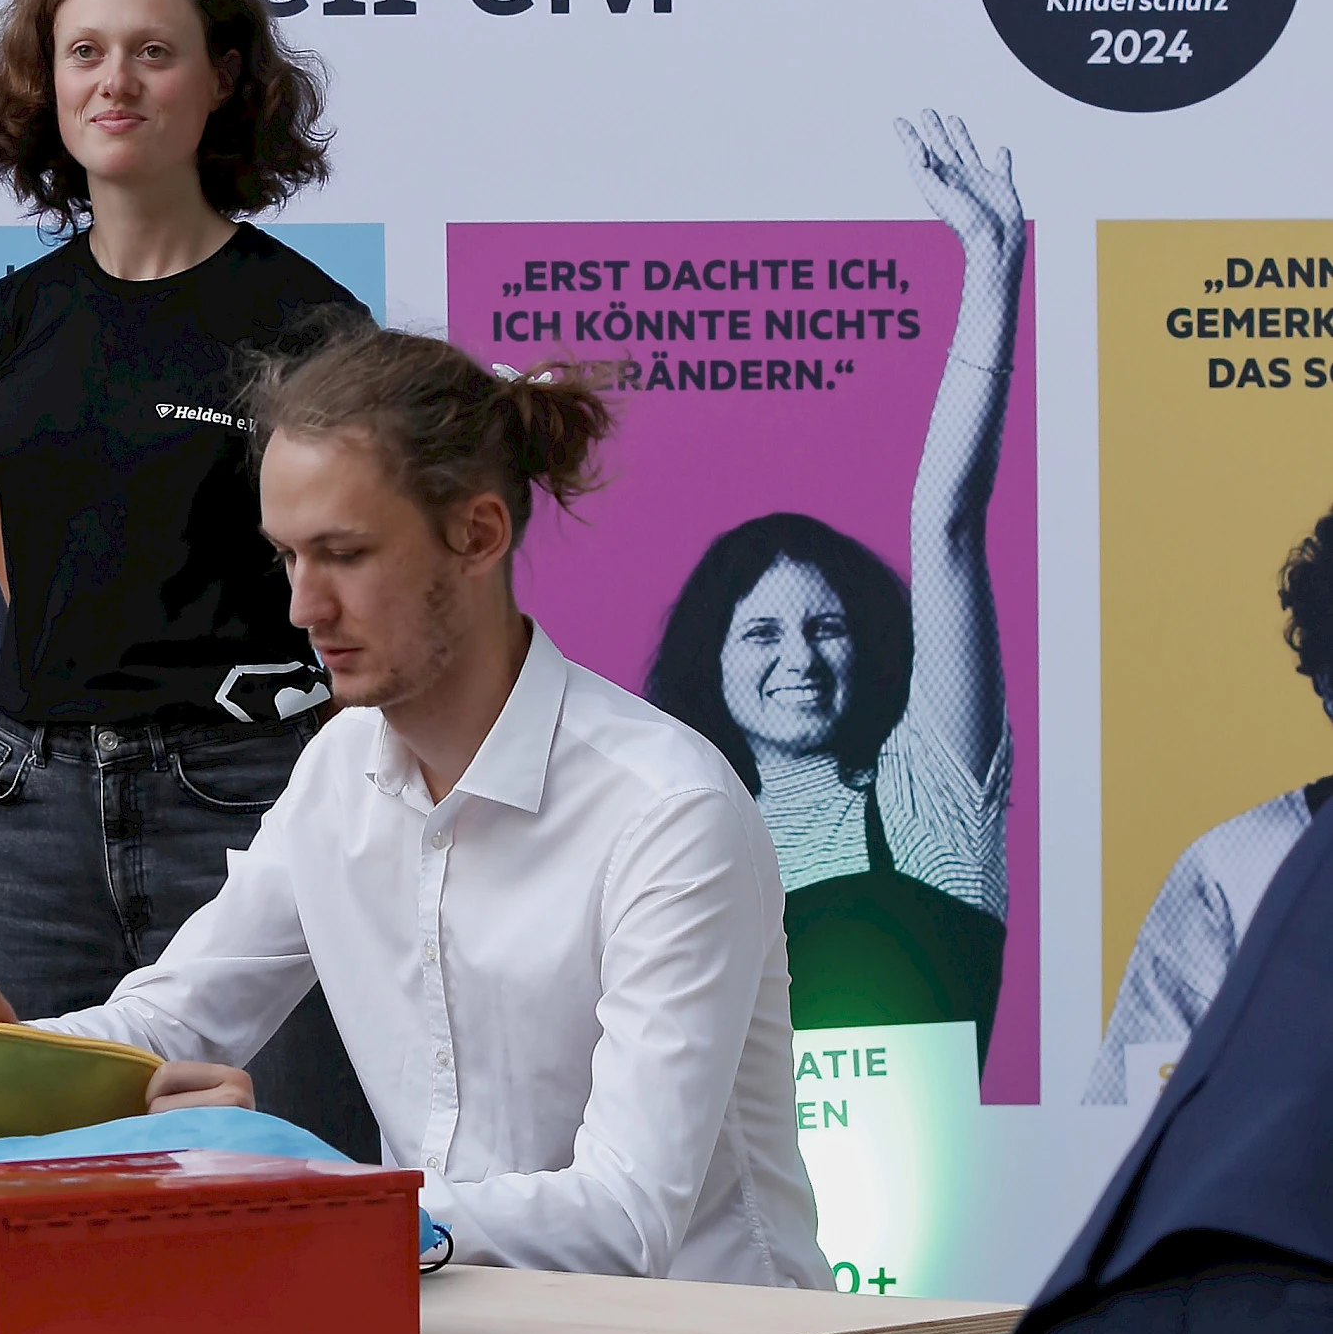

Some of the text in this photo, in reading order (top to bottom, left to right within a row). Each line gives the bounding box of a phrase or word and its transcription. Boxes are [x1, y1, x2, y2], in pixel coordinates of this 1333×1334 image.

[1086, 28, 1194, 65] 2024
[502, 259, 910, 297] „ERST DACHTE ICH,
[493, 301, 921, 342] ICH KÖNNTE NICHTS
[1208, 357, 1333, 389] DAS S
[174, 406, 232, 426] Helden
